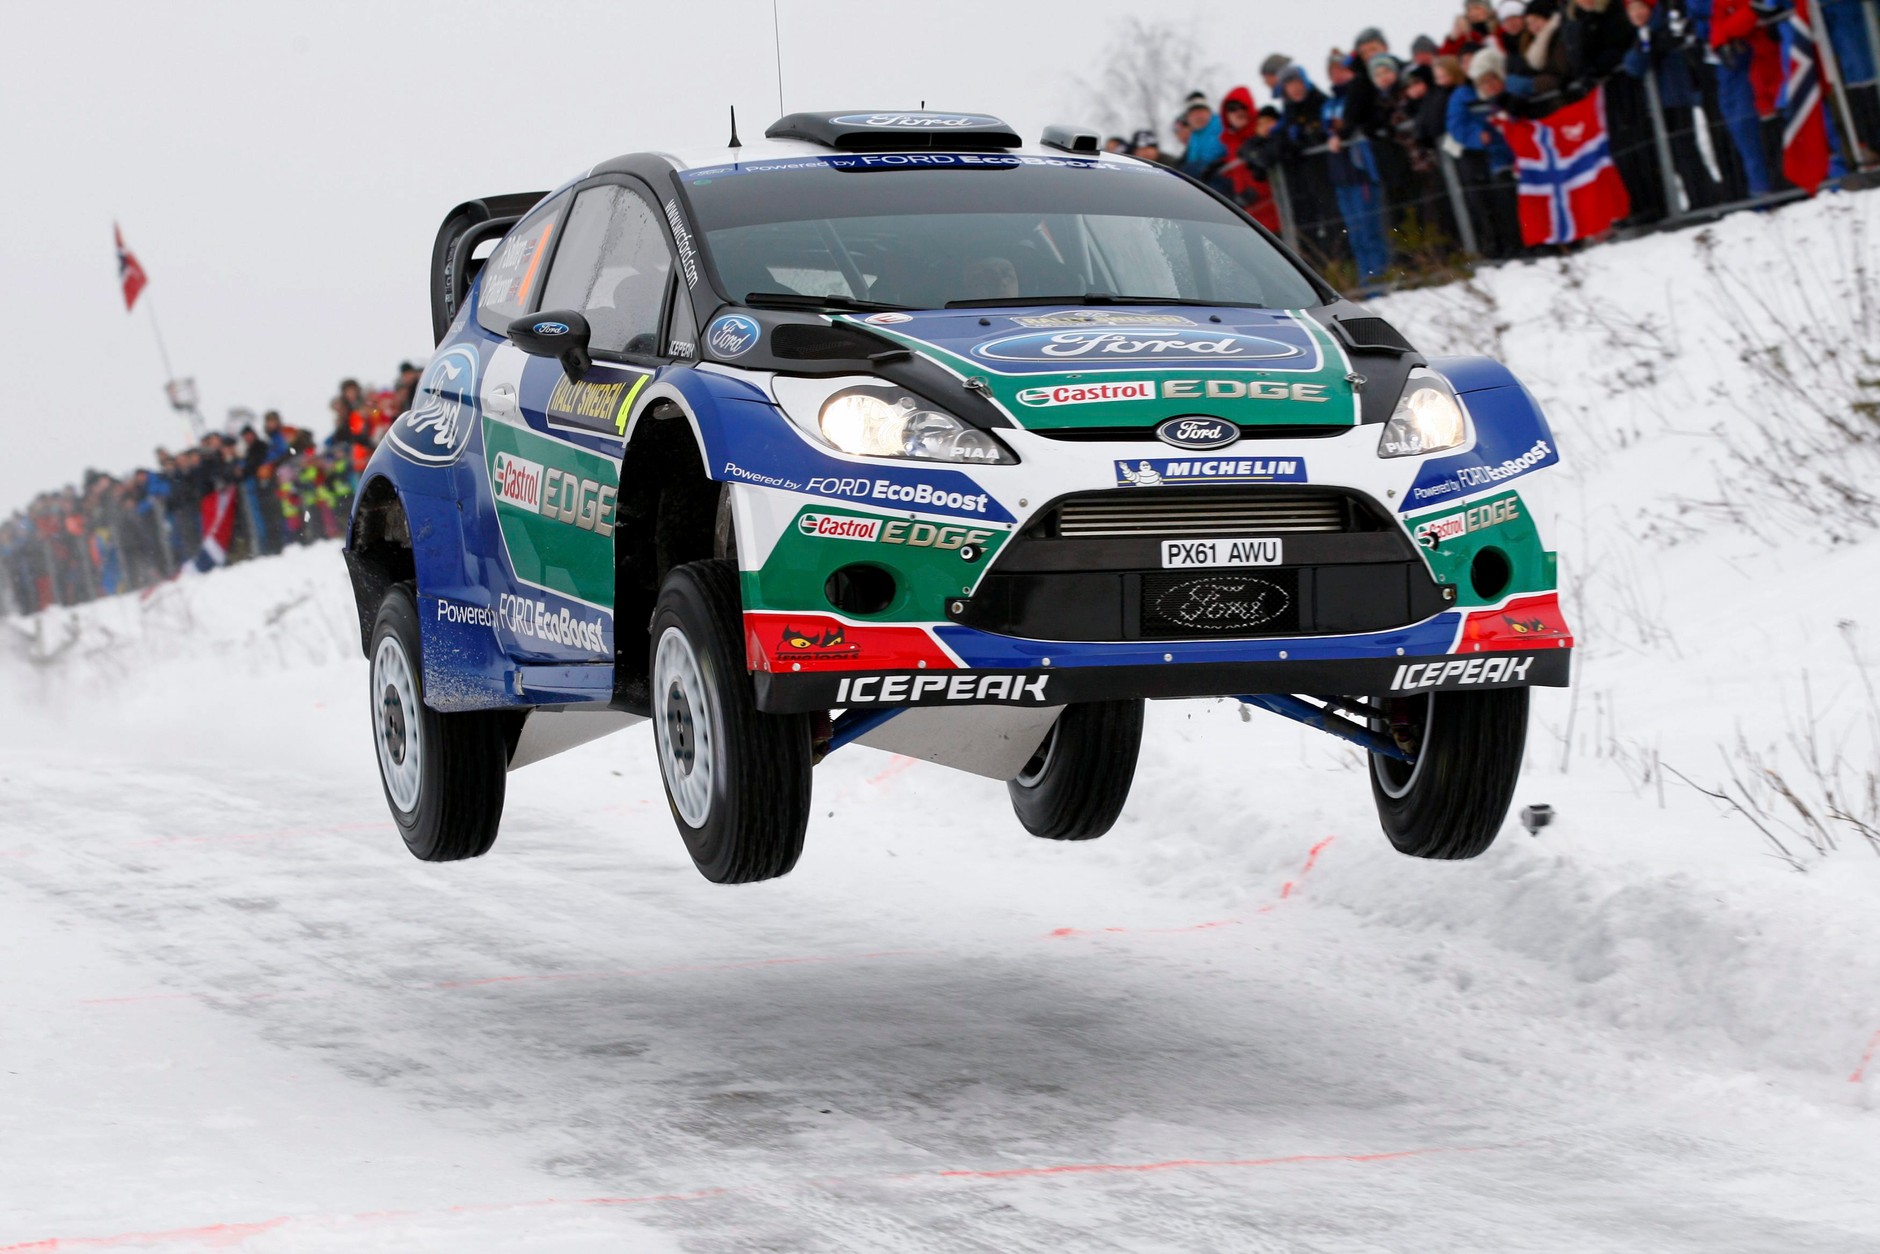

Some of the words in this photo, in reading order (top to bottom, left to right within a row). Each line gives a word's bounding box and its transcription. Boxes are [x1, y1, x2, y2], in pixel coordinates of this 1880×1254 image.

[866, 114, 972, 128] Ford
[745, 160, 829, 173] Powered
[833, 159, 855, 168] by
[861, 154, 951, 166] FORD
[960, 155, 1121, 170] EcoBoost
[665, 199, 698, 290] www.wrcford.com
[538, 324, 562, 334] Ford
[712, 318, 752, 354] Ford
[1041, 332, 1244, 355] Ford
[668, 340, 695, 358] ICEPEAK
[407, 360, 463, 449] Ford
[551, 377, 587, 413] RALLY
[577, 382, 627, 420] SWEDEN
[1052, 383, 1149, 402] Castrol
[1161, 379, 1331, 402] EDGE
[1176, 420, 1222, 440] Ford
[950, 447, 1000, 459] PIAA
[1165, 461, 1297, 476] MICHELIN
[1413, 478, 1450, 500] Powered
[1449, 479, 1461, 491] by
[1456, 465, 1492, 488] FORD
[1486, 439, 1552, 482] EcoBoost
[503, 460, 540, 506] Castrol
[541, 467, 618, 537] EDGE
[724, 462, 783, 487] Powered
[783, 480, 802, 491] by
[805, 477, 870, 497] FORD
[871, 480, 989, 513] EcoBoost
[817, 516, 875, 539] Castrol
[879, 520, 996, 551] EDGE
[1428, 515, 1464, 540] Castrol
[1466, 495, 1519, 533] EDGE
[1167, 543, 1218, 564] PX61
[1228, 540, 1278, 562] AWU
[1180, 584, 1266, 621] Ford
[437, 599, 490, 628] Powered
[500, 592, 534, 637] FORD
[533, 601, 609, 655] EcoBoost
[836, 674, 1049, 703] ICEPEAK
[1390, 656, 1535, 691] ICEPEAK
